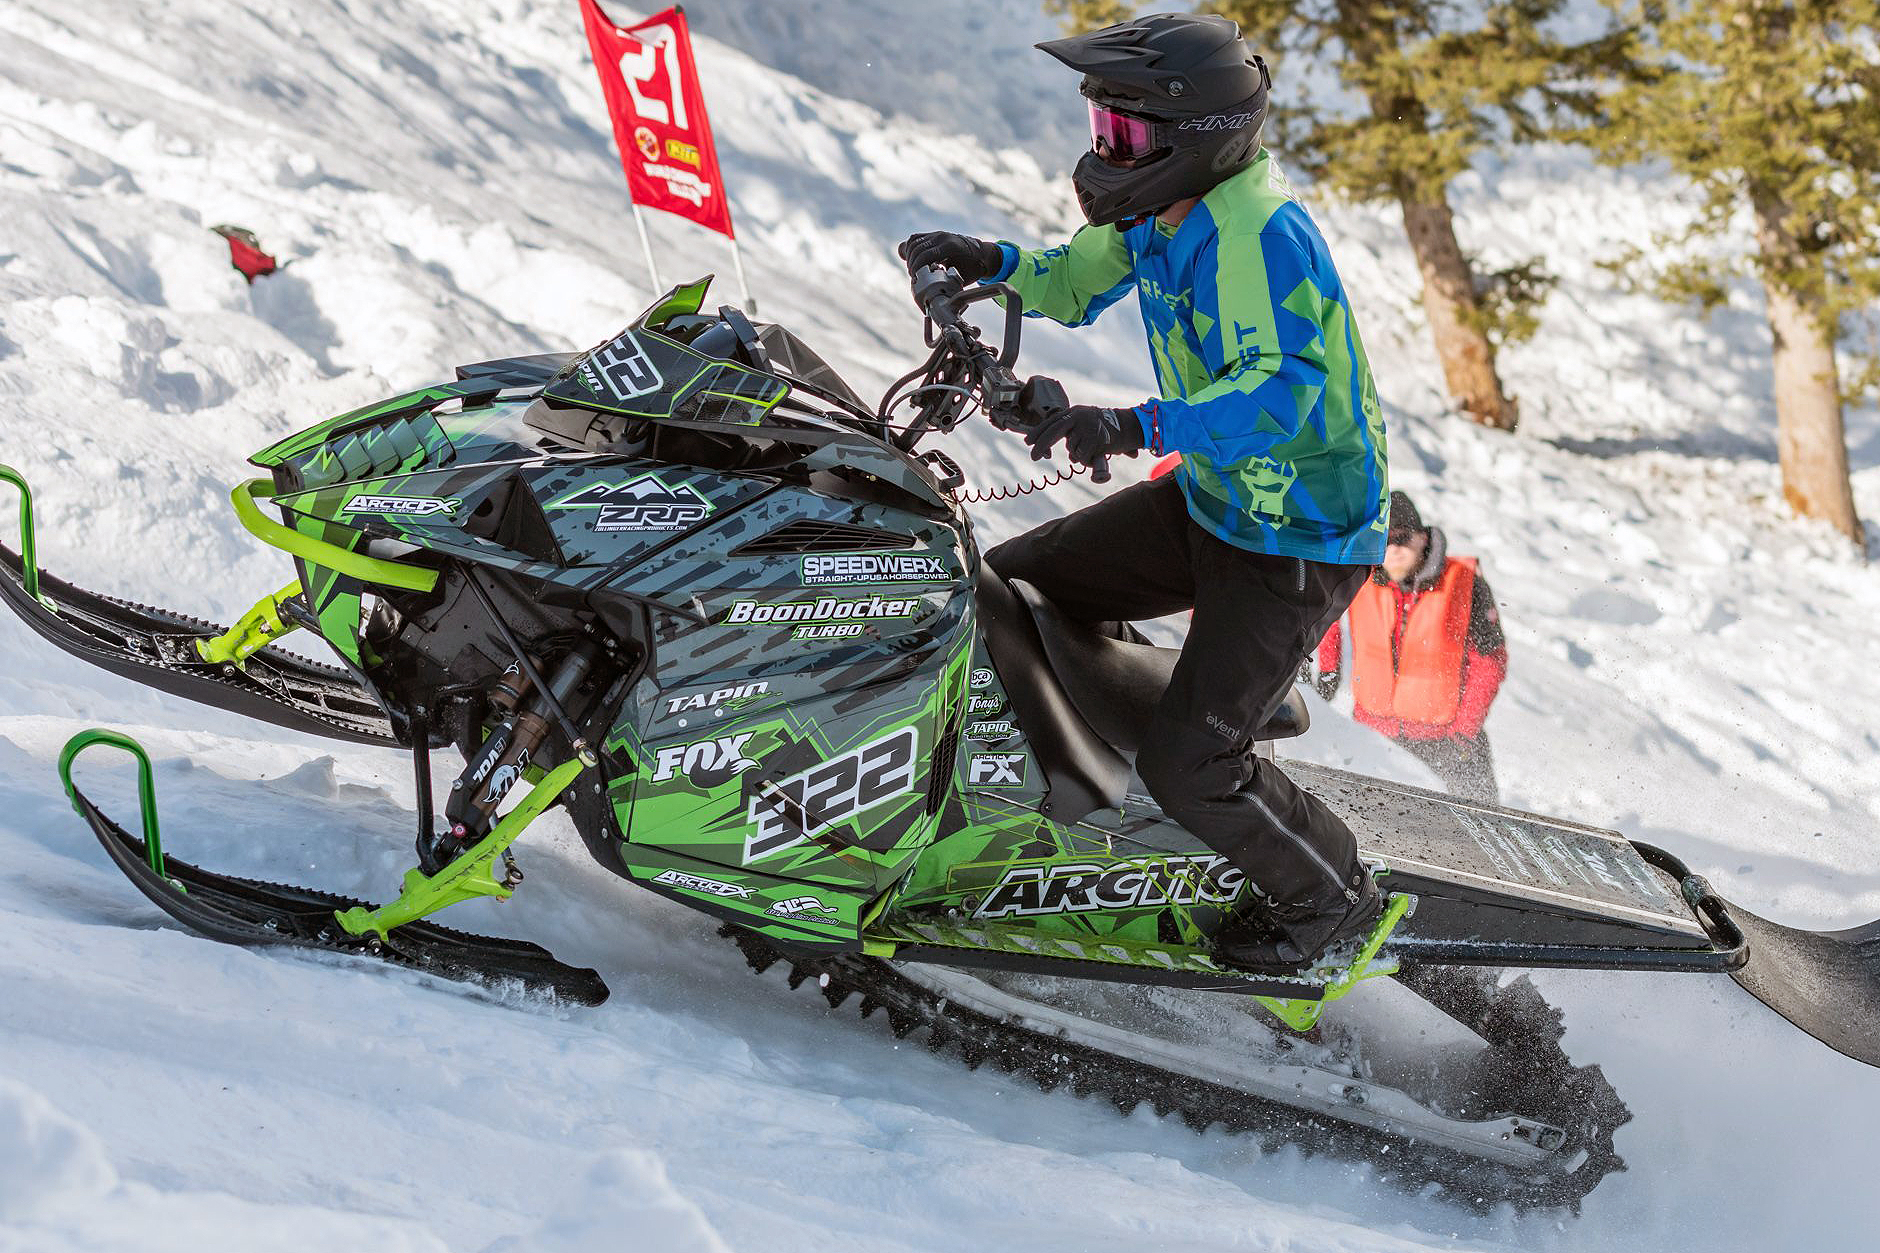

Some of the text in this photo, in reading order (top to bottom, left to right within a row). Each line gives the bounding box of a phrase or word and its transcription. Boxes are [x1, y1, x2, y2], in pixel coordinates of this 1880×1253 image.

[1178, 109, 1262, 131] HMK
[596, 504, 706, 526] ZRP
[803, 556, 945, 576] SPEEDWERX
[728, 597, 918, 623] BoonDocker
[797, 623, 863, 638] TURBO
[651, 731, 760, 786] FOX
